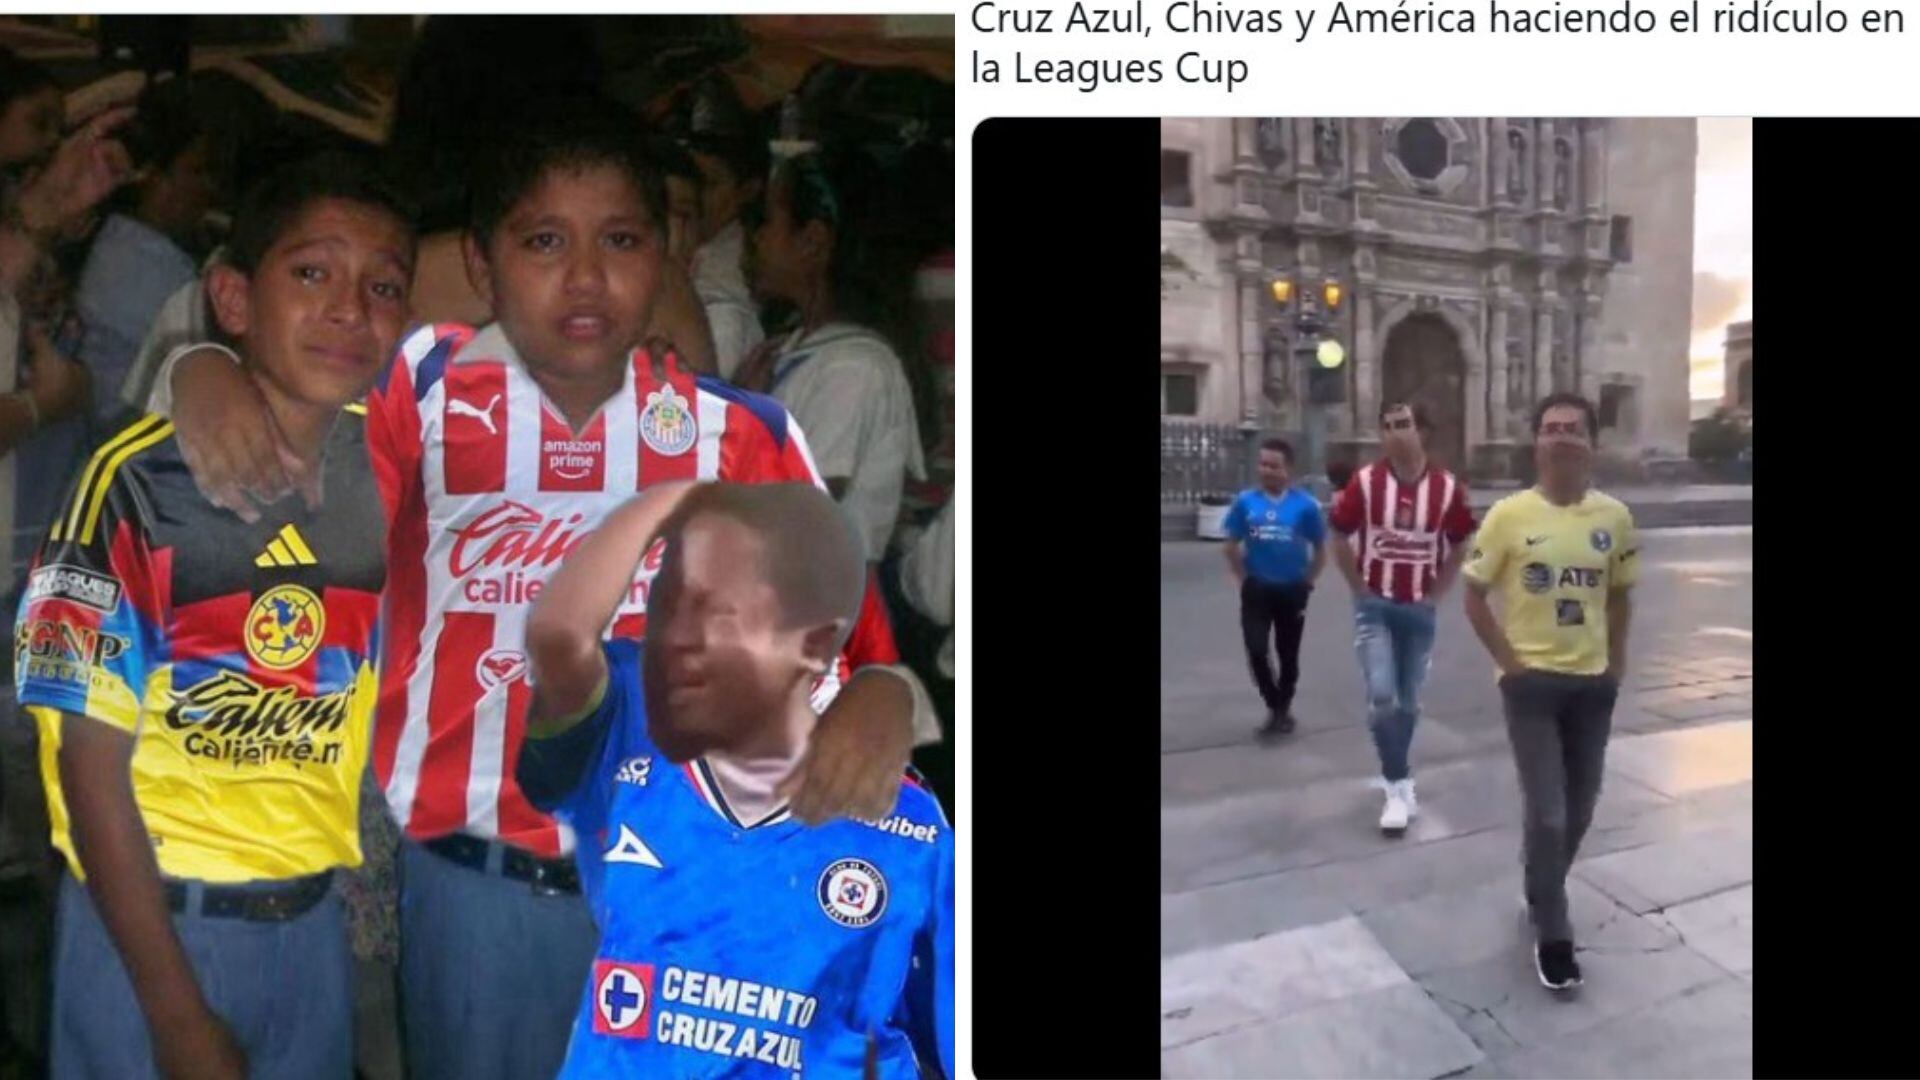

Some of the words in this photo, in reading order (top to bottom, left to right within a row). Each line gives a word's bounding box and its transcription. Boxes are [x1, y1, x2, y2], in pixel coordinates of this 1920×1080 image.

[544, 440, 602, 452] amazon
[550, 453, 595, 470] prime
[847, 815, 939, 844] vibet
[661, 965, 818, 1029] CEMENTO
